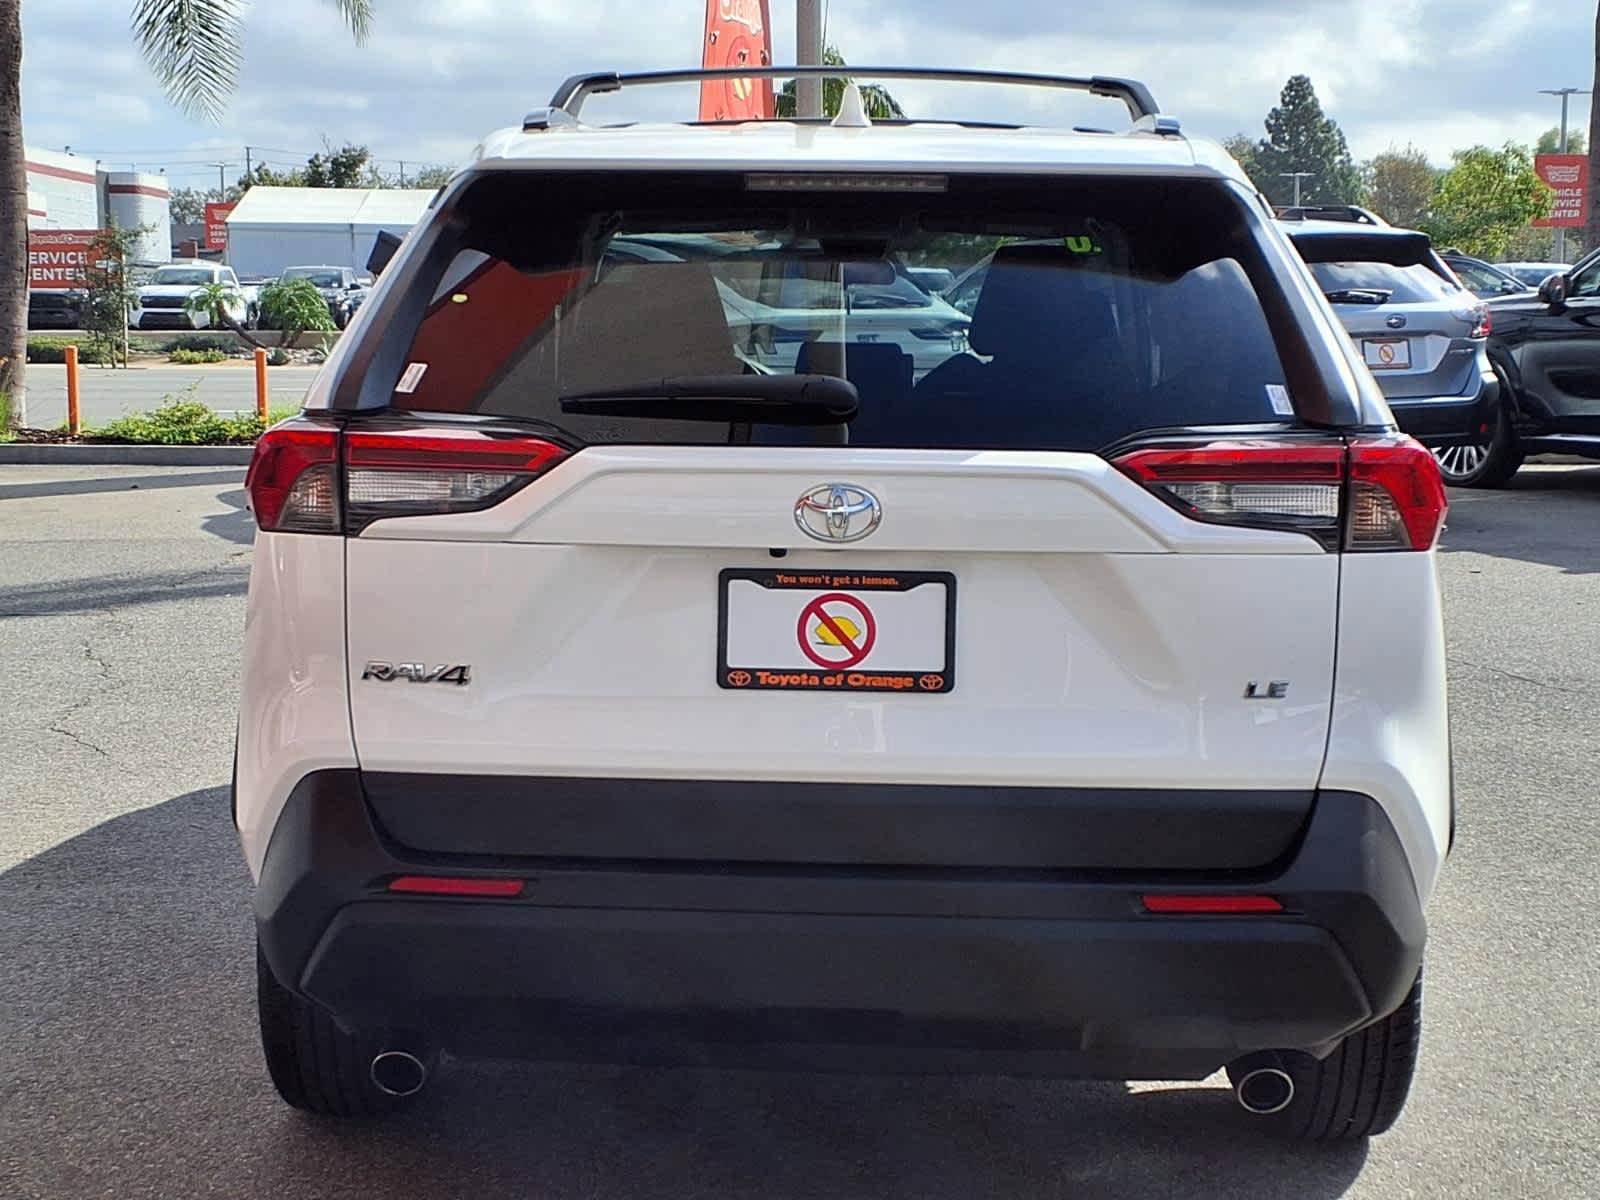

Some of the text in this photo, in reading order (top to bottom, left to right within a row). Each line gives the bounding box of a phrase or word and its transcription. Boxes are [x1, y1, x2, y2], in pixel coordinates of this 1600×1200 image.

[1548, 209, 1580, 218] ENTER
[29, 251, 87, 265] ERVICE
[31, 268, 87, 281] ENTER
[776, 574, 899, 587] You won't get a lemon.
[361, 660, 471, 686] RAV4
[756, 671, 914, 689] Toyota of Orange
[1243, 680, 1289, 699] LE
